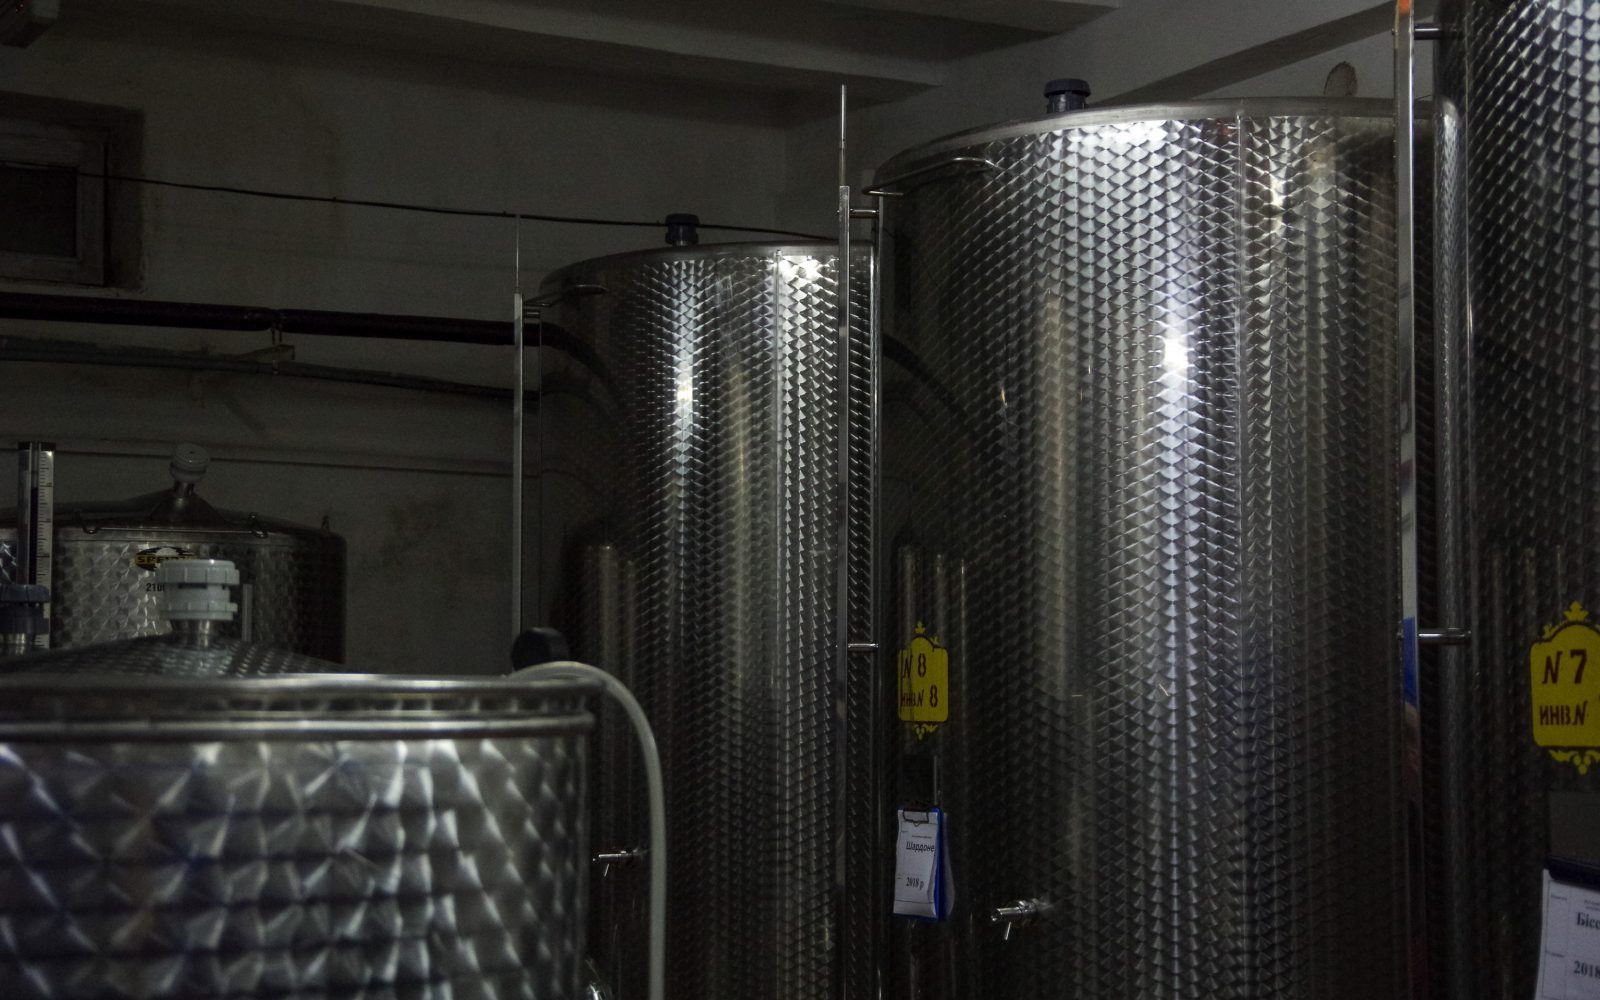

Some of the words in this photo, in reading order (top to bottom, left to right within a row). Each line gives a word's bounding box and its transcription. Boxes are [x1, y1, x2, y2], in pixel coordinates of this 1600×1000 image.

[918, 653, 926, 678] 8
[1570, 649, 1587, 684] 7
[930, 684, 938, 708] 8
[906, 841, 935, 853] Шардоне
[906, 876, 920, 888] 2018
